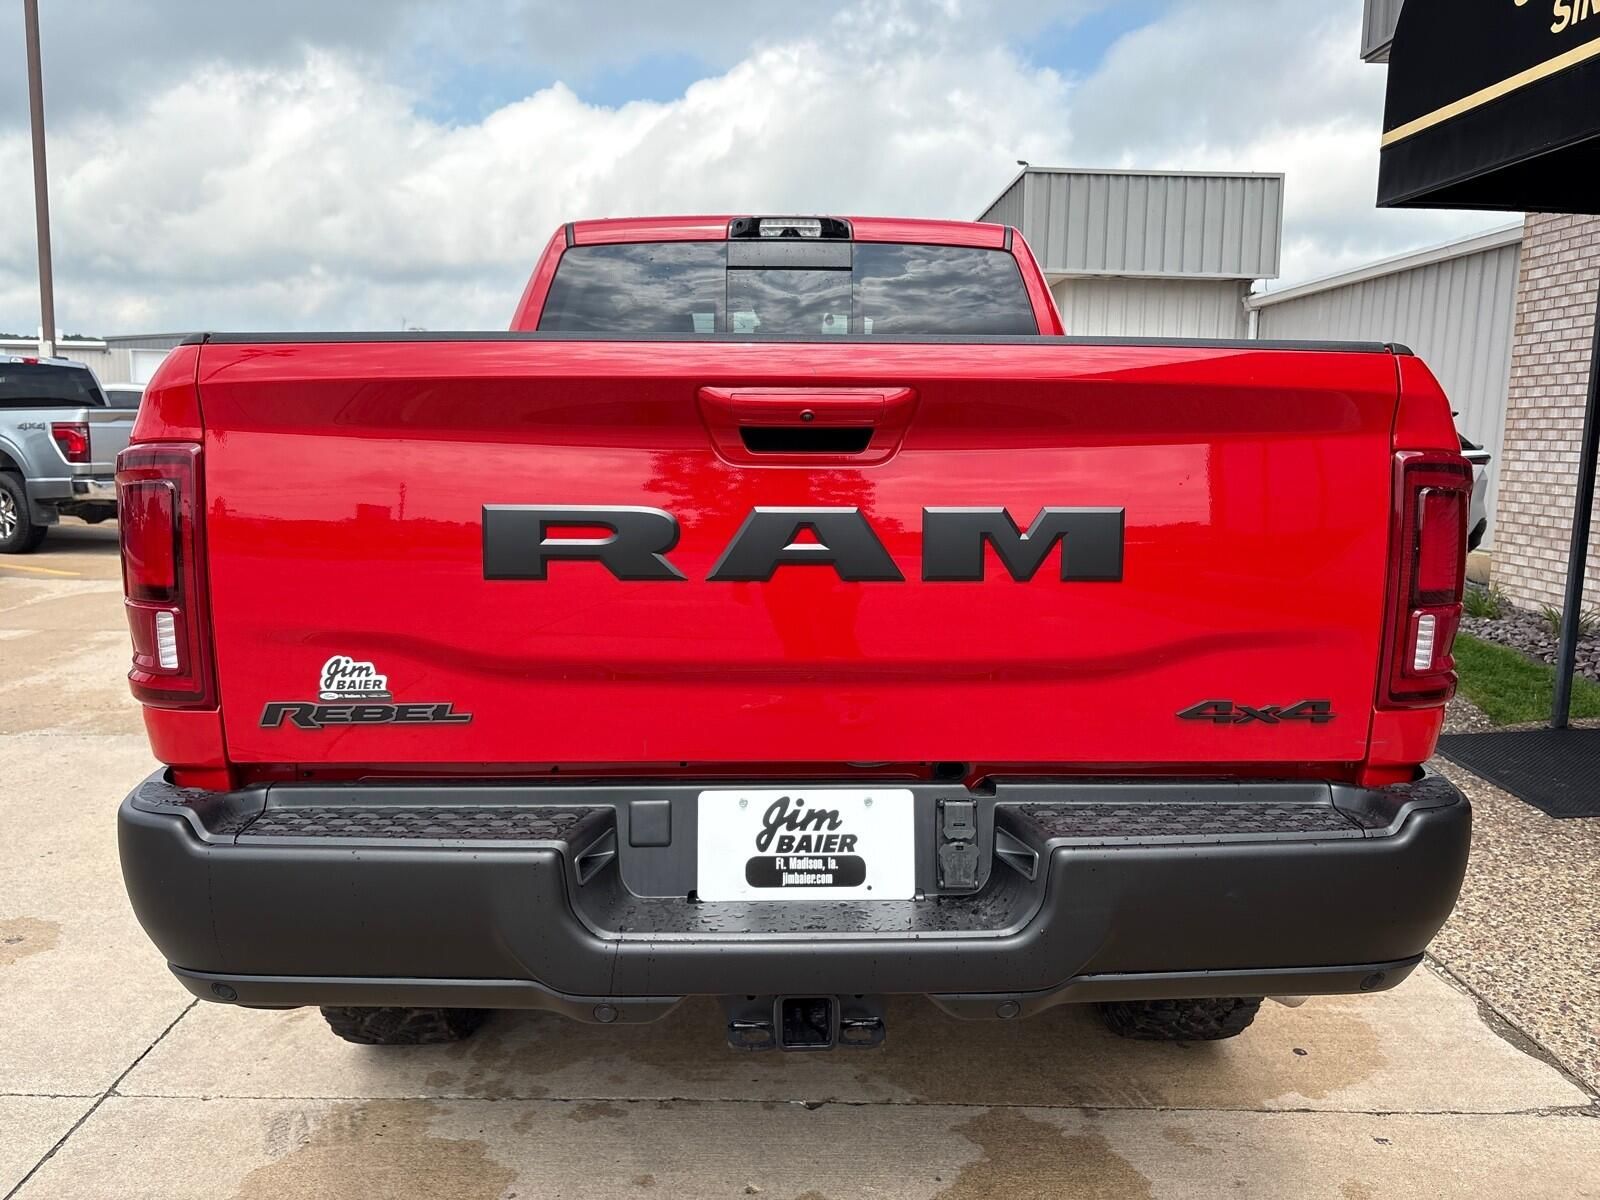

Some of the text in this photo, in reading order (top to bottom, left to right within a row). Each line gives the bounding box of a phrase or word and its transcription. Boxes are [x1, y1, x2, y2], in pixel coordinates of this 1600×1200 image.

[481, 504, 1126, 582] RAM
[324, 658, 373, 689] Jim
[336, 679, 383, 690] BAIER
[259, 701, 473, 729] REBEL
[756, 796, 842, 853] Jim
[775, 834, 858, 853] BAIER
[775, 856, 839, 871] Ft. Madison, Ia.
[782, 872, 833, 887] jimbaier.com
